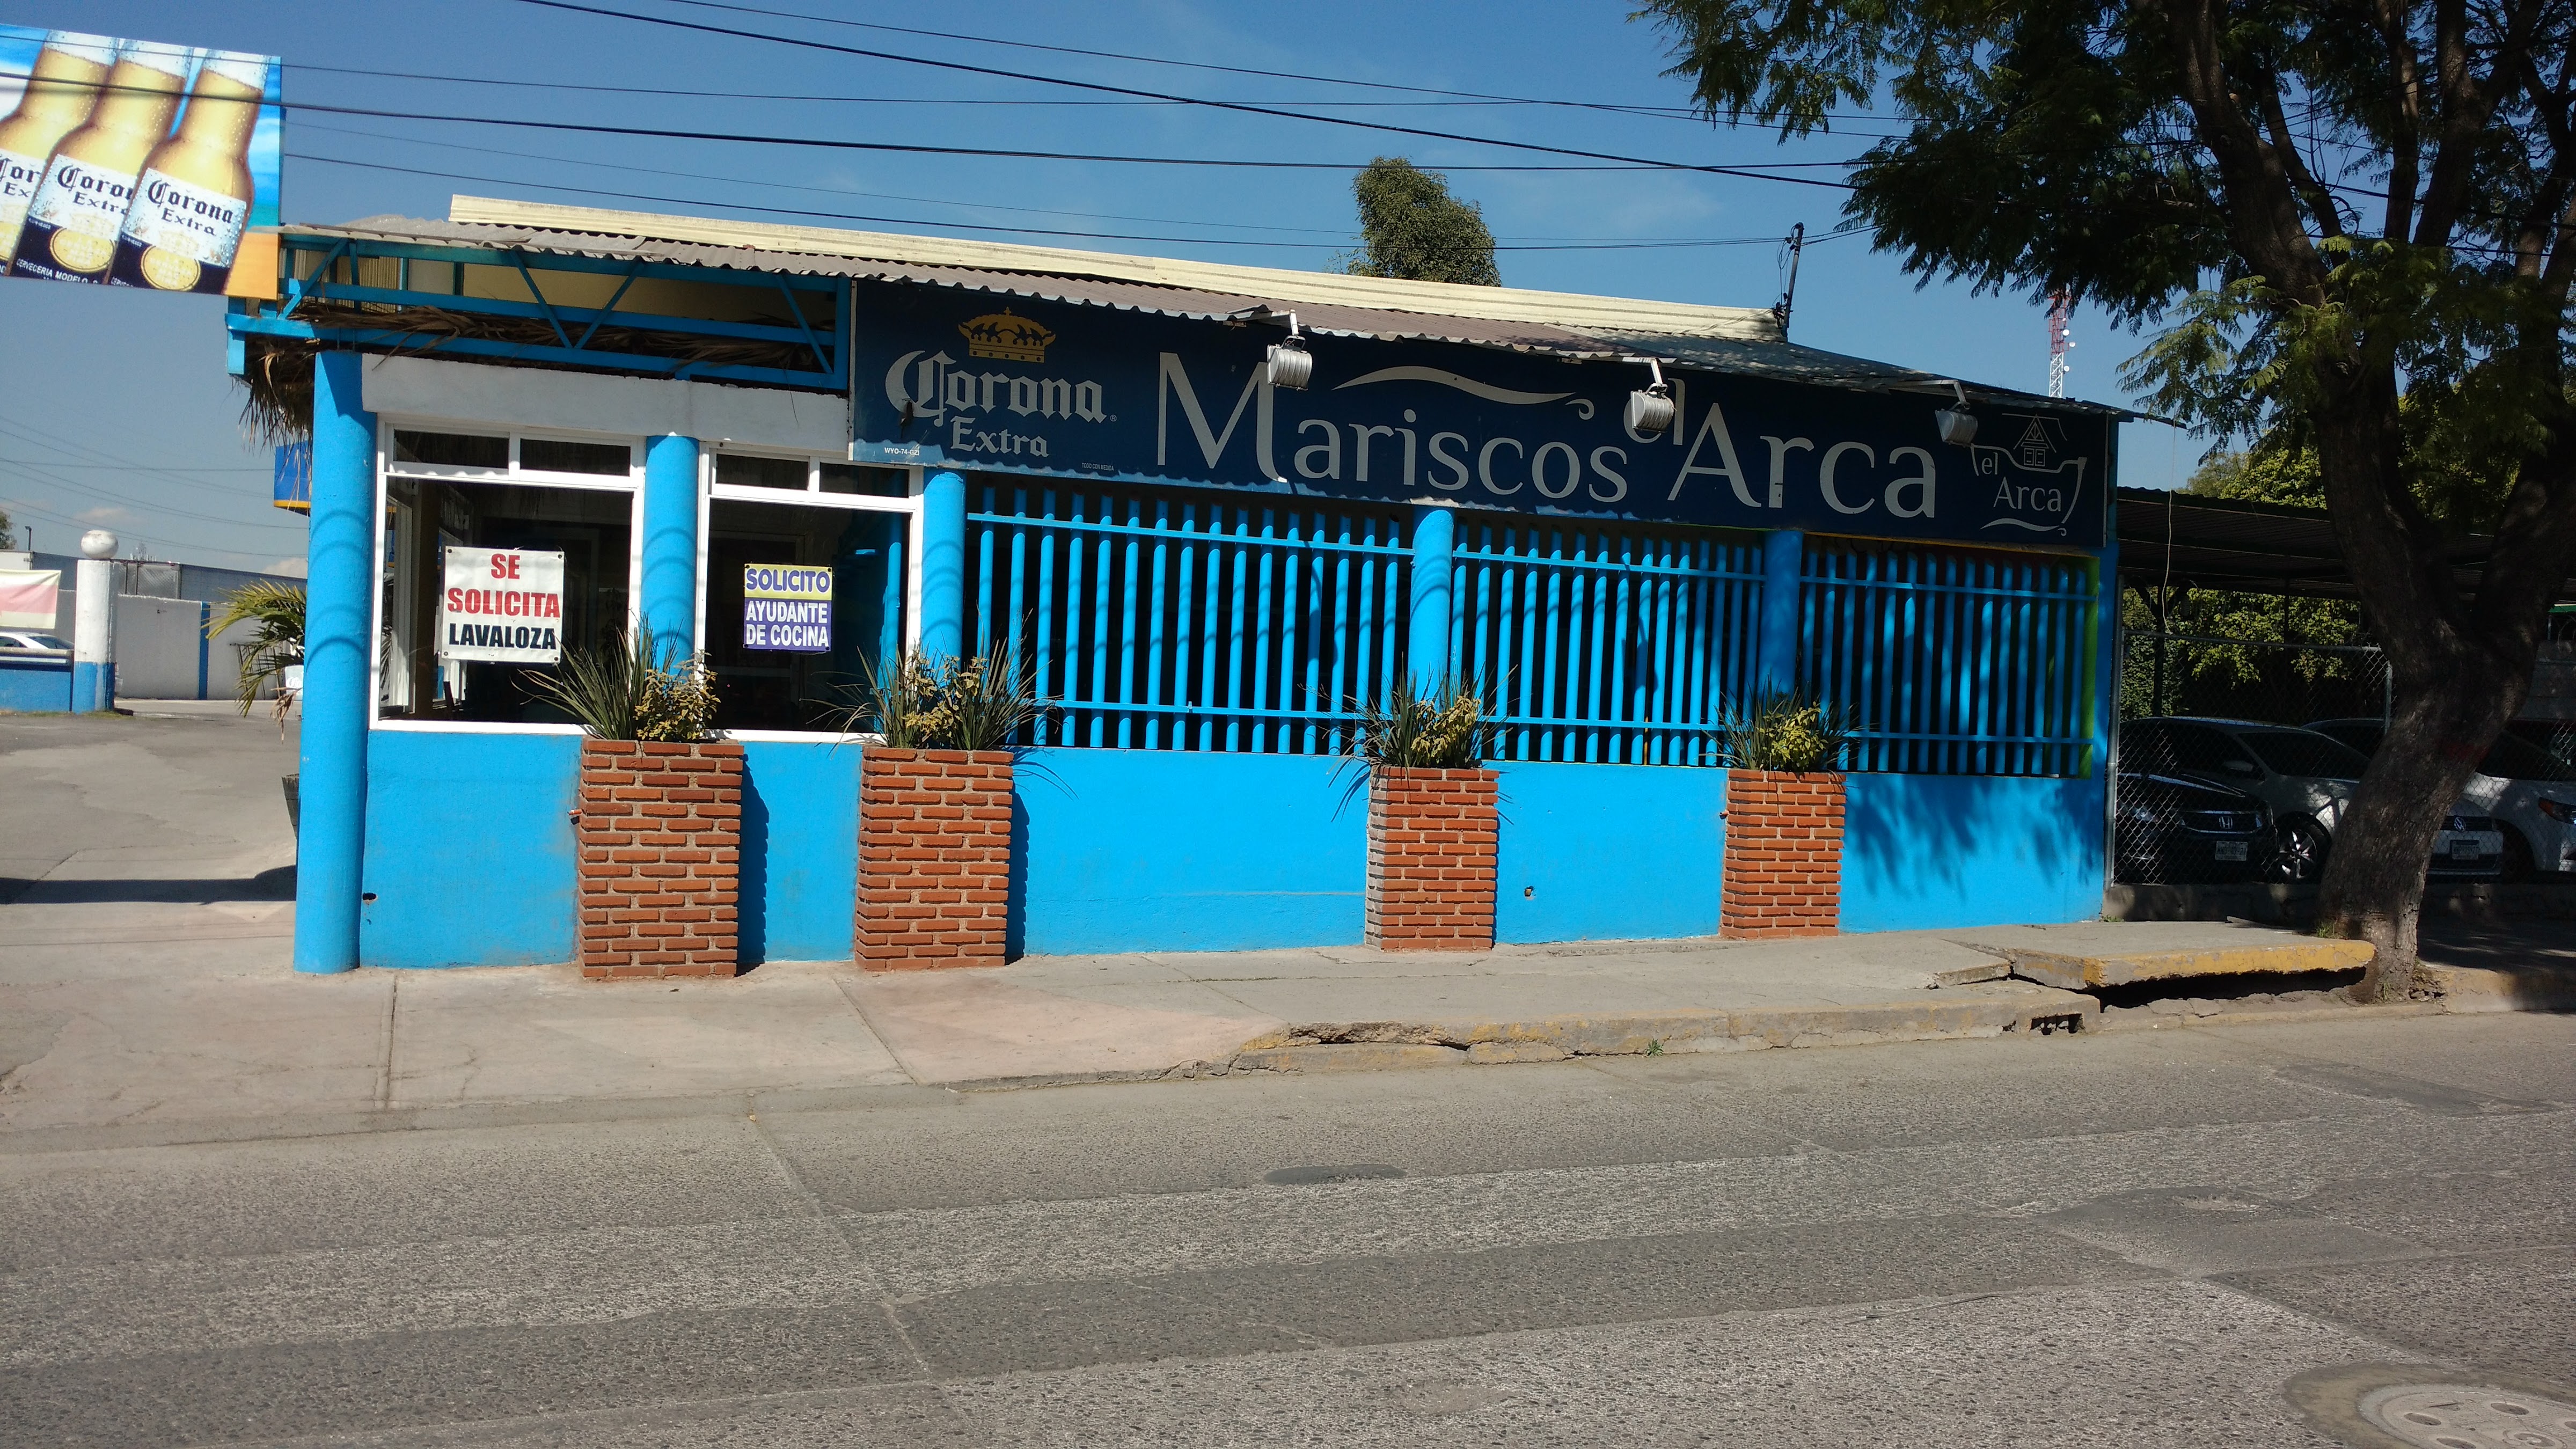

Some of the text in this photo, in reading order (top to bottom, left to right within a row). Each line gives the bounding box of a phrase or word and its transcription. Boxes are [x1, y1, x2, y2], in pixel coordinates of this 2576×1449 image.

[148, 180, 233, 224] Corona
[161, 208, 216, 236] Extra
[16, 258, 53, 277] CERVECERIA
[885, 350, 1107, 427] Corona
[950, 416, 1049, 457] Extra
[1157, 352, 1627, 502] Mariscos
[1667, 402, 1936, 518] Arca
[1981, 452, 1998, 474] el
[1993, 477, 2061, 511] Arca
[491, 553, 520, 579] SE
[747, 568, 830, 592] SOLICITO
[447, 588, 560, 618] SOLICITA
[746, 601, 828, 623] AYUDANTE
[449, 623, 557, 649] LAVALOZA
[746, 624, 829, 647] DE COCINA
